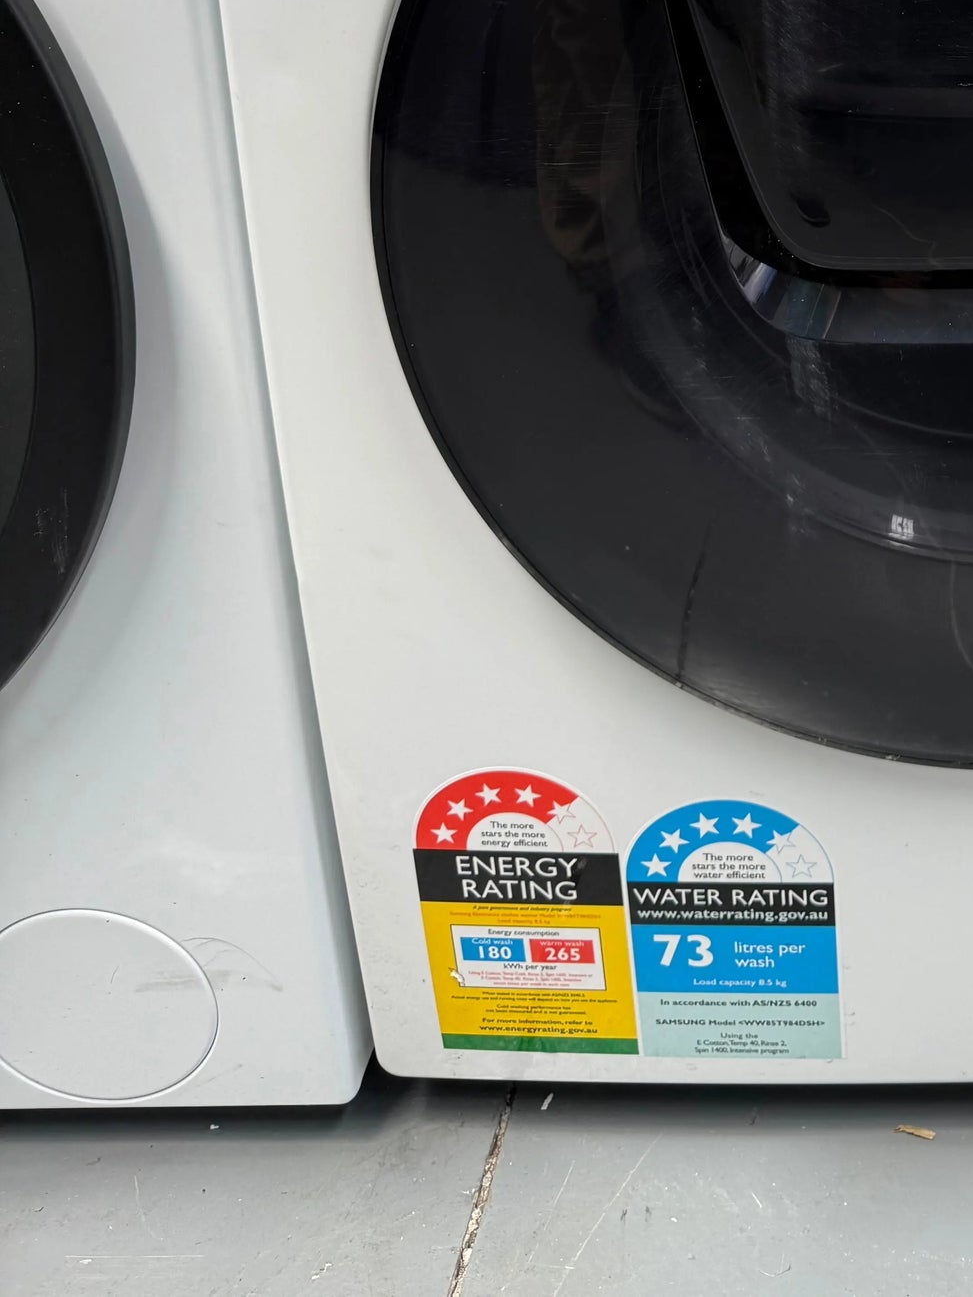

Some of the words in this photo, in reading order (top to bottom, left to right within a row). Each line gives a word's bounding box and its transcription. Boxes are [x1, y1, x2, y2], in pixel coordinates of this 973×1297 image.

[490, 821, 508, 829] The
[481, 840, 510, 848] energy
[513, 839, 548, 847] efficient
[702, 852, 723, 861] The
[726, 854, 754, 862] more
[455, 855, 578, 877] ENERGY
[719, 862, 736, 870] the
[726, 871, 766, 879] efficient
[461, 879, 578, 900] RATING
[633, 888, 723, 906] WATER
[732, 889, 828, 906] RATING
[637, 909, 828, 923] www.waterrating.gov.au
[488, 928, 512, 936] Energy
[471, 937, 491, 945] Cold
[479, 945, 512, 959] 180
[545, 947, 581, 961] 265
[653, 934, 714, 967] 73
[734, 941, 773, 954] litres
[779, 943, 806, 957] per
[735, 956, 775, 968] wash
[693, 978, 717, 986] Load
[719, 979, 757, 988] capacity
[758, 978, 773, 986] 8.5
[776, 979, 788, 988] kg
[672, 999, 727, 1007] accordance
[729, 999, 751, 1007] with
[752, 999, 792, 1007] AS/NZS
[655, 1018, 706, 1026] SAMSUNG
[480, 1025, 598, 1035] www.energyrating.gov.au
[720, 1032, 743, 1040] Using
